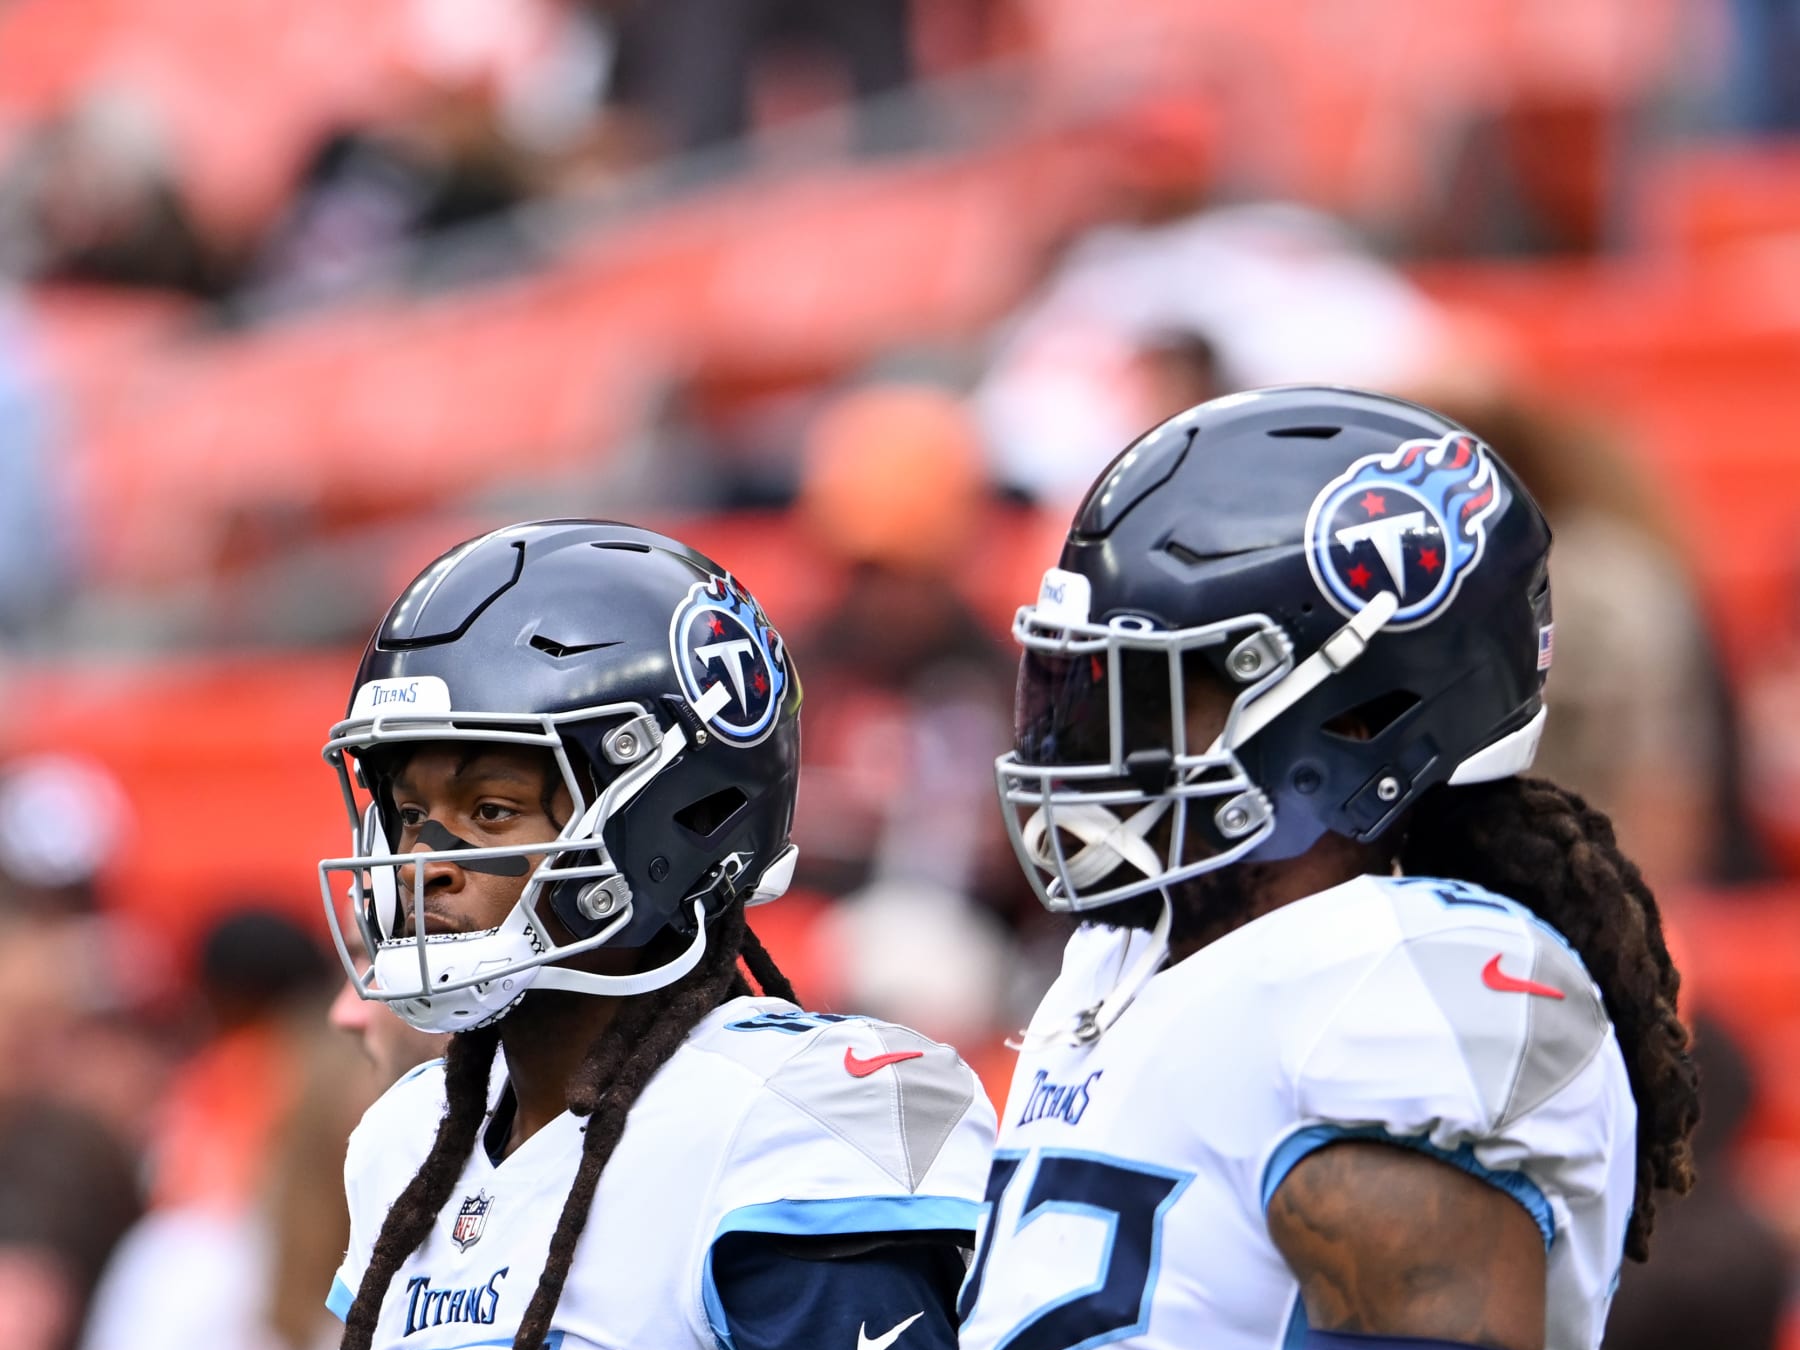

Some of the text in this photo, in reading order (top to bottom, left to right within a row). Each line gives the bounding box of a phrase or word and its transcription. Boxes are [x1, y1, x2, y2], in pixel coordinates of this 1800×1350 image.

[371, 681, 419, 706] TITANS
[454, 1216, 478, 1241] NFL
[403, 1266, 510, 1338] TITANS
